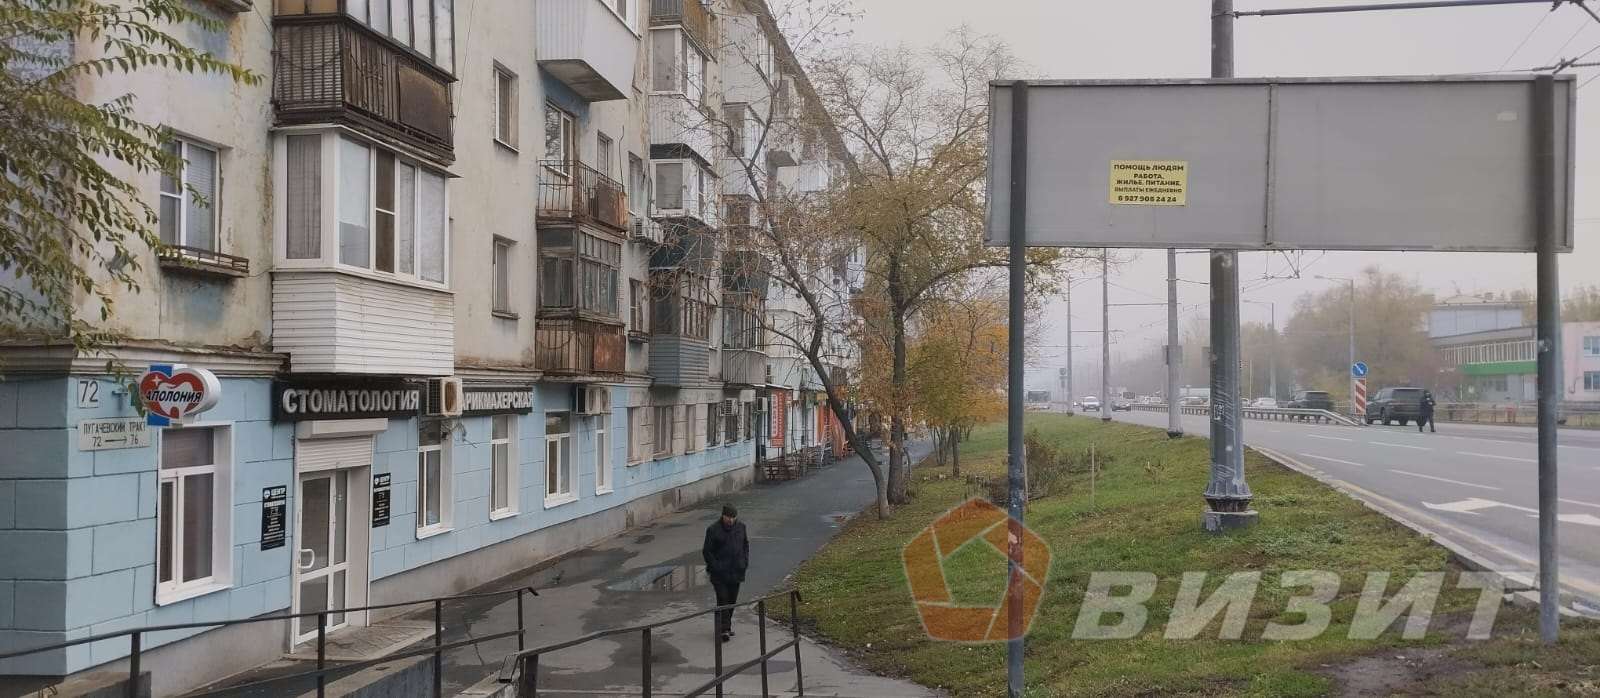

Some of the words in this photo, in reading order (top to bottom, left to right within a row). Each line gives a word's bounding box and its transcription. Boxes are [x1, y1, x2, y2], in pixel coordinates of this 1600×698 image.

[79, 380, 99, 403] 72
[282, 388, 420, 413] СТОМАТОЛОГИЯ
[462, 391, 534, 411] АРИКМАХЕРСКАЯ
[92, 436, 102, 447] 72
[130, 434, 139, 445] 76
